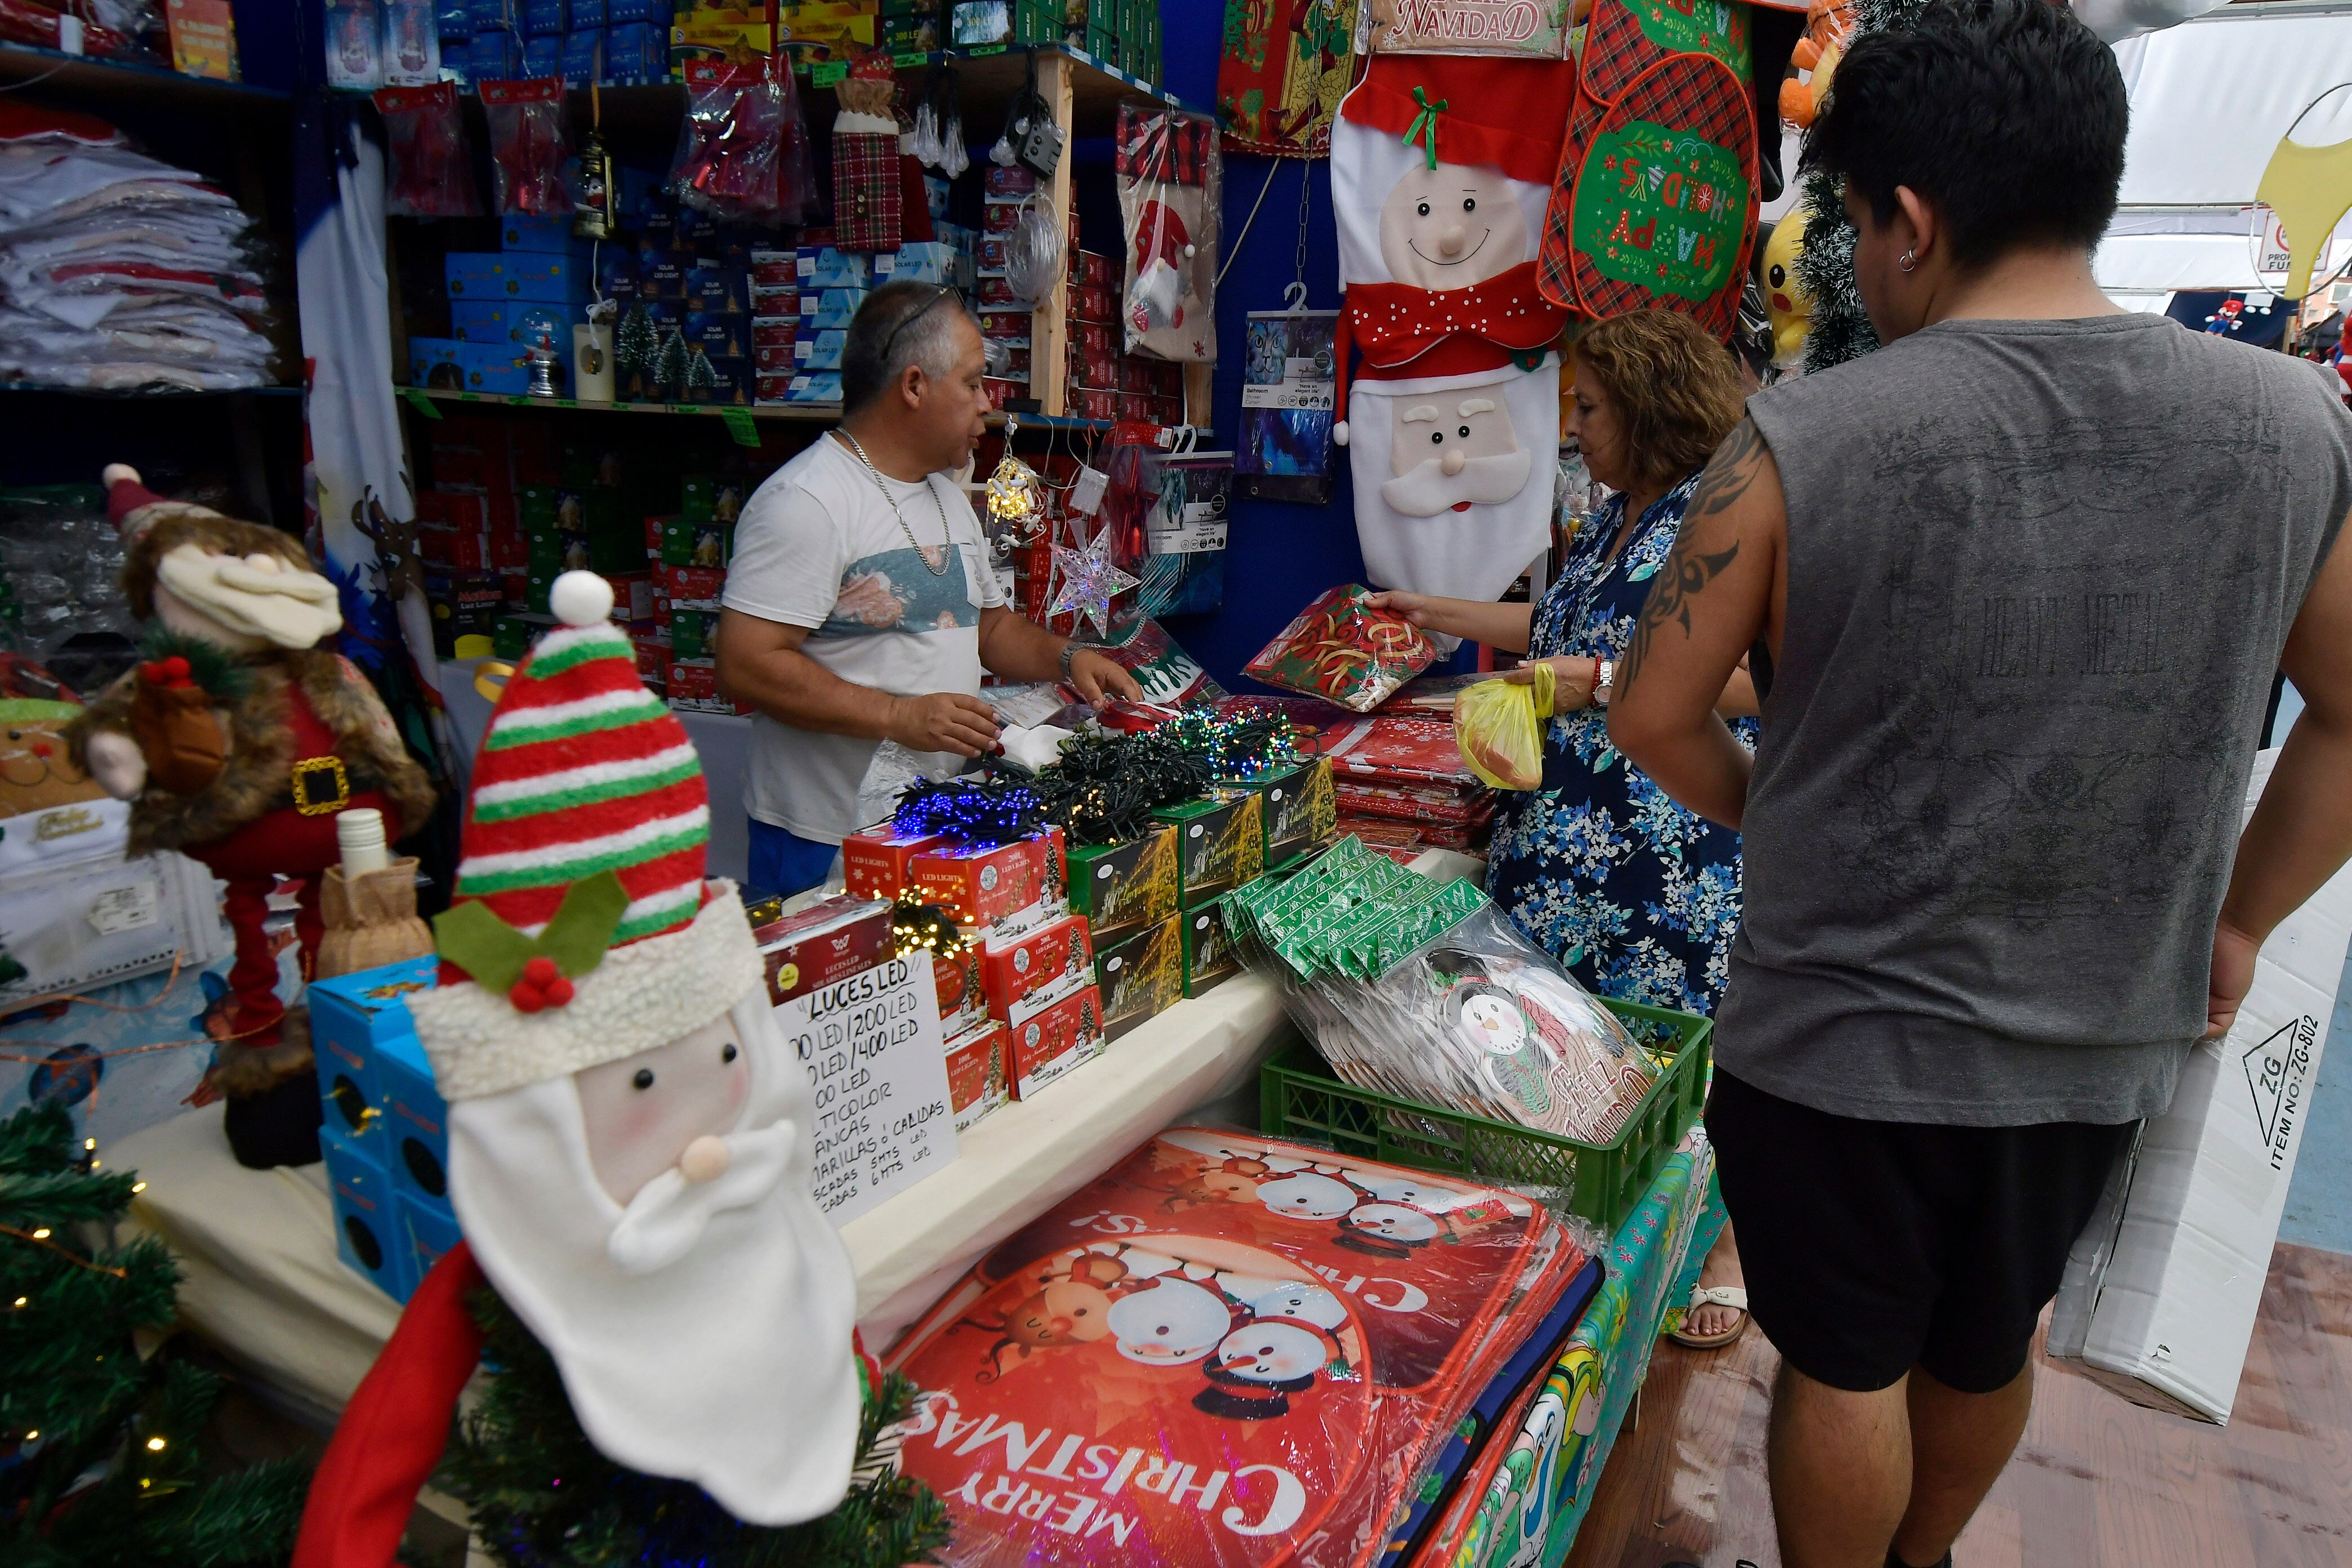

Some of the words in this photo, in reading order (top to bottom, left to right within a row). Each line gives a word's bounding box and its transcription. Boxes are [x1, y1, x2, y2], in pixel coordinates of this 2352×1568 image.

[1392, 0, 1540, 42] NAVIDAD
[1665, 0, 1745, 54] HAPP
[867, 858, 889, 867] LIGHTS
[1001, 865, 1012, 874] LED
[1012, 858, 1031, 871] LIGHTS
[937, 874, 961, 883] LIGHTS
[1035, 946, 1045, 955] LED
[1044, 939, 1059, 952] LIGHTS
[1046, 1021, 1055, 1029] LED
[1055, 1014, 1070, 1026] LIGHTS
[842, 1068, 871, 1094] LED
[2260, 1056, 2281, 1095] ZG
[910, 1129, 928, 1144] LED
[2270, 1117, 2292, 1171] ITEM
[913, 1146, 930, 1162] LED
[904, 1391, 1306, 1536] CHRISTMAS
[942, 1471, 1139, 1548] MERRY
